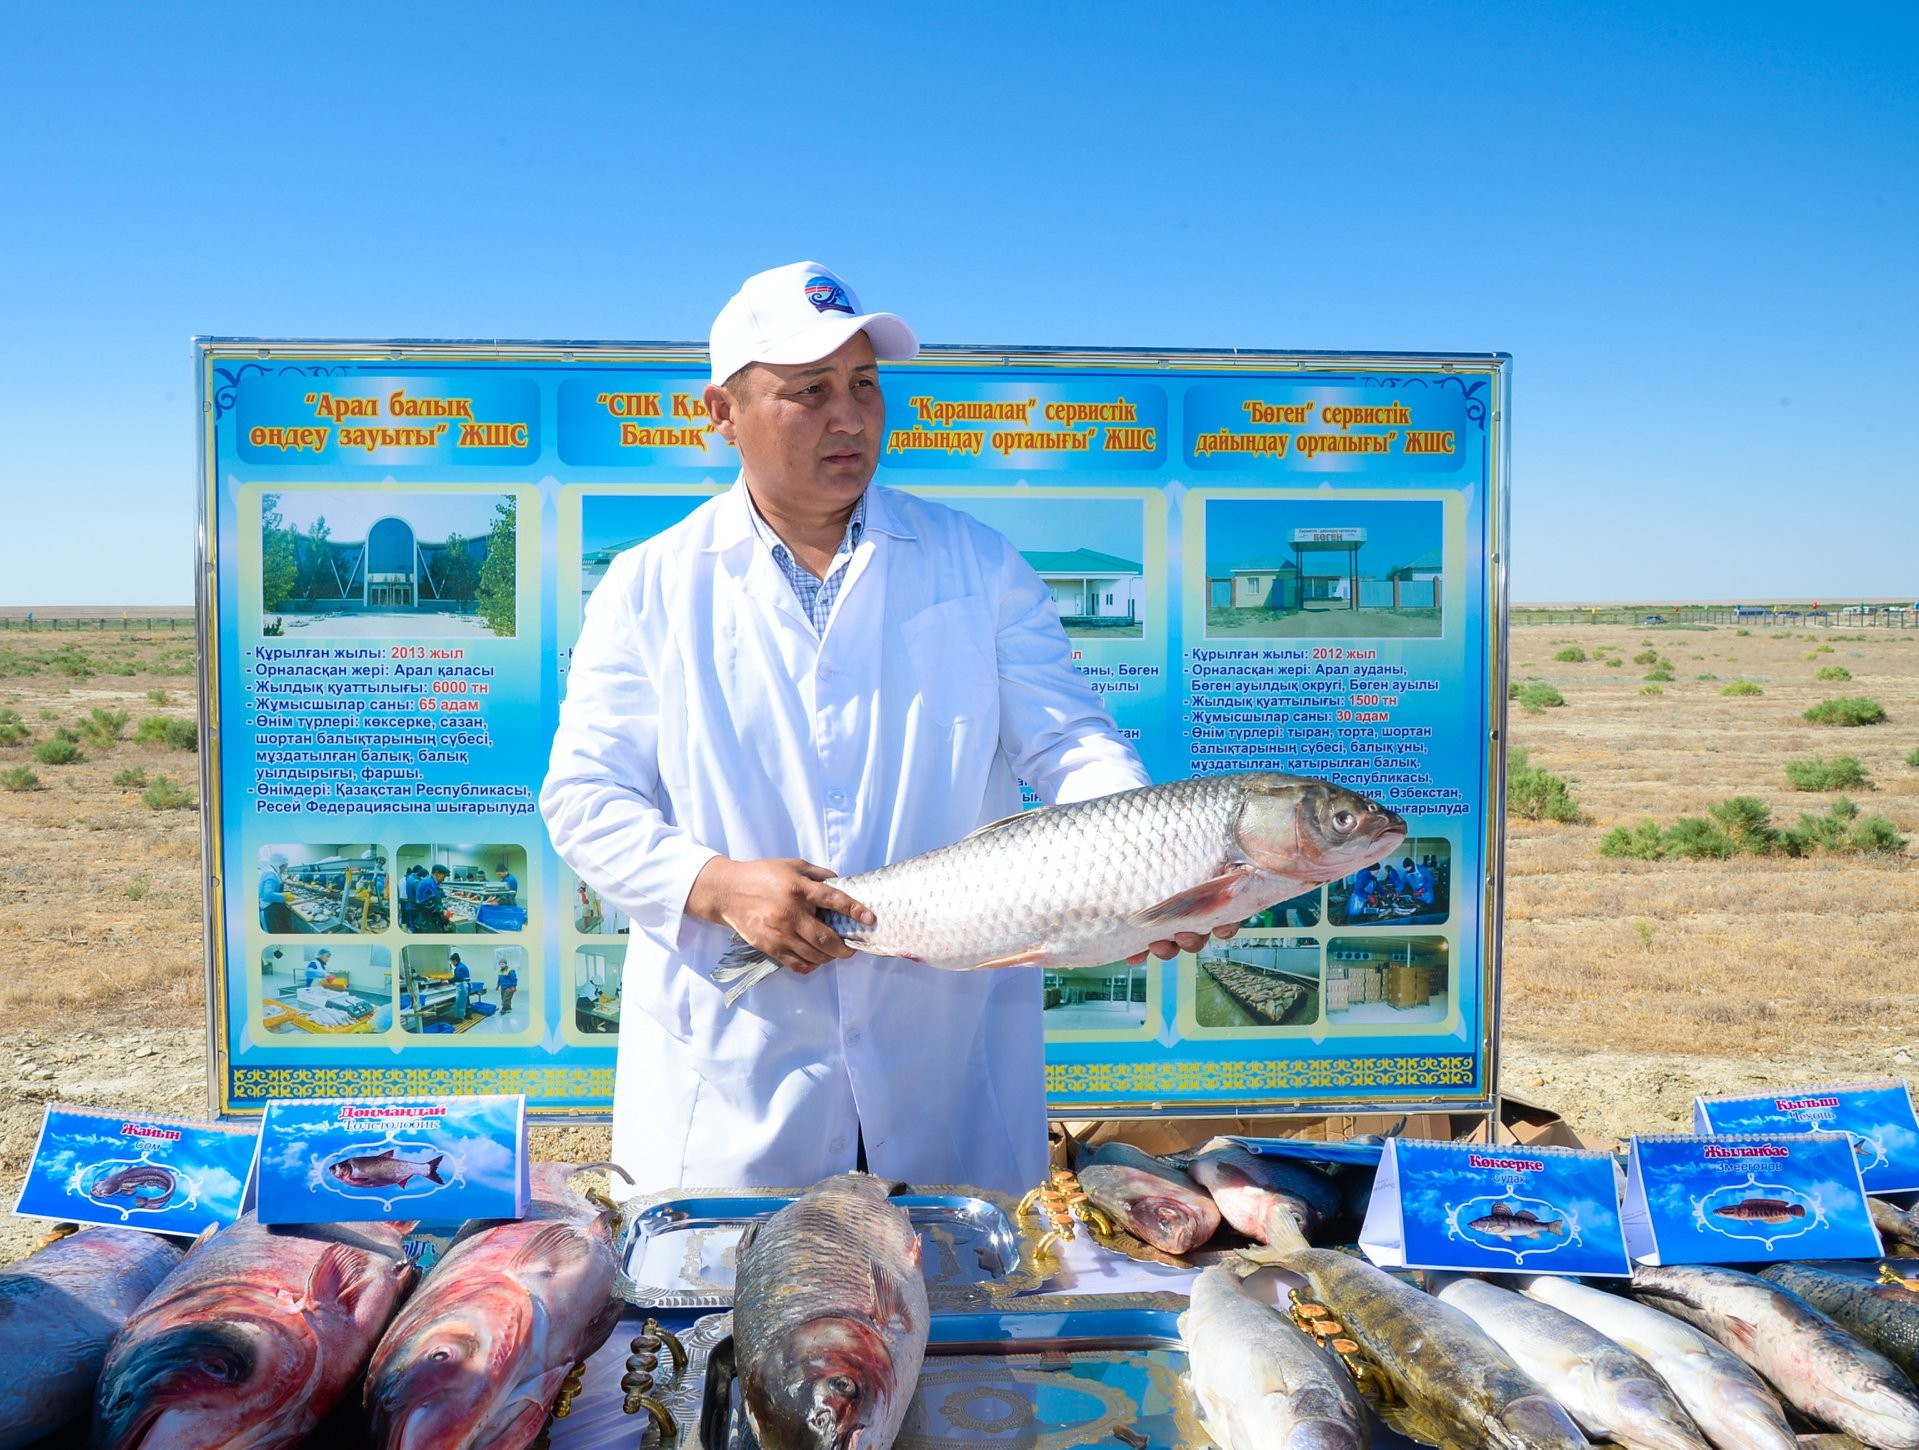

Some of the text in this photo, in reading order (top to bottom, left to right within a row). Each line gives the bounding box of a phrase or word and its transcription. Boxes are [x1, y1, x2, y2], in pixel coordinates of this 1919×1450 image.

[304, 389, 474, 423] "Арал балық
[597, 393, 662, 417] "СПК
[909, 396, 1137, 428] "Қарашалаң" сервистік
[1243, 400, 1412, 430] "Бөген" сервистік
[249, 423, 528, 452] өңдеу зауыты" ЖШС
[620, 422, 716, 452] Балық"
[886, 425, 1156, 456] дайындау орталығы" ЖШС
[1194, 428, 1455, 459] дайындау орталығы" ЖШС
[255, 646, 330, 661] Құрылған
[334, 648, 386, 659] жылы:
[391, 646, 425, 659] 2013
[430, 649, 464, 659] жыл
[1192, 648, 1259, 661] Құрылған
[1262, 650, 1308, 659] жылы:
[1313, 648, 1343, 659] 2012
[1346, 651, 1376, 659] жыл
[255, 663, 347, 678] Орналасқан
[351, 663, 389, 678] жері:
[394, 663, 433, 678] Арал
[438, 666, 494, 678] қаласы
[1118, 664, 1159, 676] Бөген
[1192, 664, 1274, 677] Орналасқан
[1278, 664, 1311, 677] жері:
[1315, 664, 1349, 677] Арал
[1353, 665, 1407, 677] ауданы,
[256, 680, 324, 694] Жылдық
[328, 683, 428, 696] қуаттылығы:
[433, 681, 467, 693] 6000
[471, 684, 488, 693] тн
[1091, 682, 1139, 694] ауылы
[1192, 680, 1439, 693] Бөген ауылдық округі, Бөген ауылы
[256, 697, 365, 713] Жұмысшылар
[370, 701, 414, 711] саны:
[419, 698, 436, 711] 65
[441, 701, 479, 712] адам
[1192, 696, 1252, 708] Жылдық
[1257, 697, 1344, 709] қуаттылығы:
[1349, 695, 1378, 706] 1500
[1382, 697, 1397, 706] тн
[256, 715, 293, 727] Өнім
[298, 715, 359, 730] түрлері:
[364, 718, 435, 730] көксерке,
[440, 718, 488, 729] сазан,
[1192, 712, 1289, 724] Жұмысшылар
[1293, 713, 1332, 721] саны:
[1336, 711, 1351, 721] 30
[1355, 713, 1389, 722] адам
[256, 733, 493, 747] шортан балықтарының сүбесі,
[1192, 727, 1224, 738] Өнім
[1229, 727, 1283, 740] түрлері:
[1288, 729, 1333, 740] тыран,
[1337, 728, 1378, 739] торта,
[1382, 727, 1431, 739] шортан
[1191, 742, 1427, 755] балықтарының сүбесі, балық ұны,
[256, 749, 468, 764] мұздатылған балық, балық
[1191, 757, 1420, 772] мұздатылған, қатырылған балық.
[256, 766, 422, 781] уылдырығы, фаршы.
[257, 783, 331, 798] Өнімдері:
[336, 784, 411, 797] Қазақстан
[416, 783, 531, 798] Республикасы,
[1390, 787, 1462, 799] Өзбекстан,
[257, 800, 535, 815] Ресей Федерациясына шығарылуда
[1789, 1111, 1835, 1121] Чехонь
[121, 1123, 181, 1140] Жайын
[343, 1119, 440, 1130] Толстолобик
[135, 1140, 161, 1151] Сом
[1704, 1144, 1789, 1158] Жыланбас
[1469, 1154, 1544, 1172] Көксерке
[1717, 1161, 1782, 1172] Змееголов
[1494, 1172, 1526, 1185] Судак
